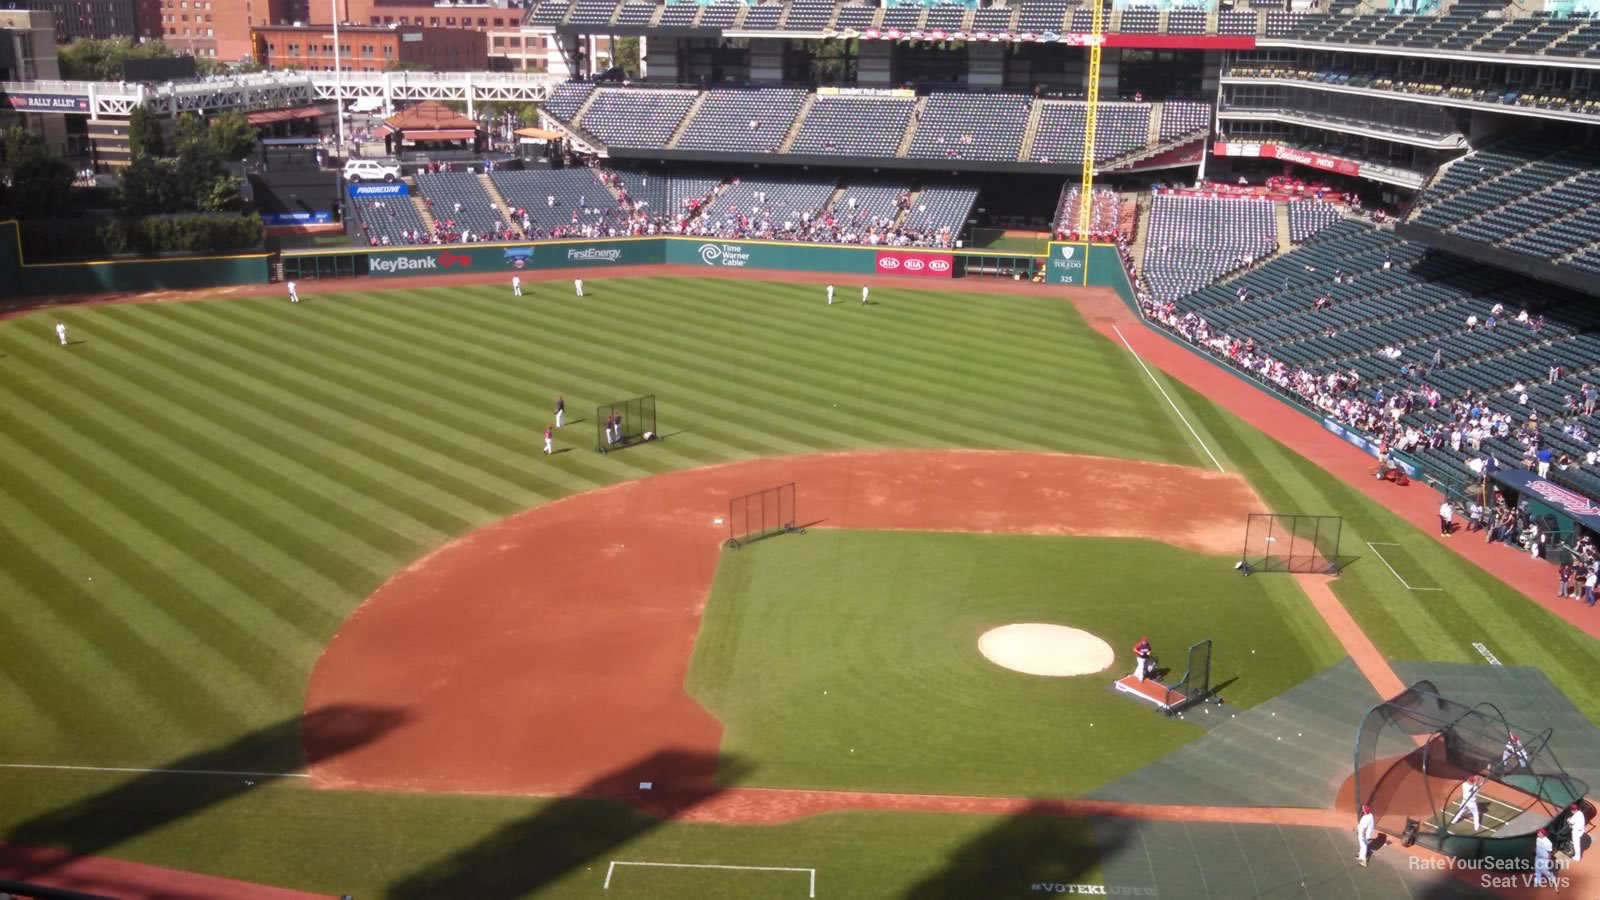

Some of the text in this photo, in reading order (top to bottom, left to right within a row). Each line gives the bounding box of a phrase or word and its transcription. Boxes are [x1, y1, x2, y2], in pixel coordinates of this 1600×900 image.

[28, 97, 51, 106] RALLY
[52, 98, 76, 107] ALLEY
[1316, 157, 1334, 168] PATIO
[356, 186, 400, 194] PROGRESSIVE
[567, 247, 621, 259] FirstEnergy
[722, 244, 741, 253] Time
[722, 251, 750, 260] Warner
[370, 256, 437, 273] KeyBank
[722, 259, 744, 267] Cable
[1054, 261, 1082, 269] TOLEDO
[1060, 275, 1073, 283] 325
